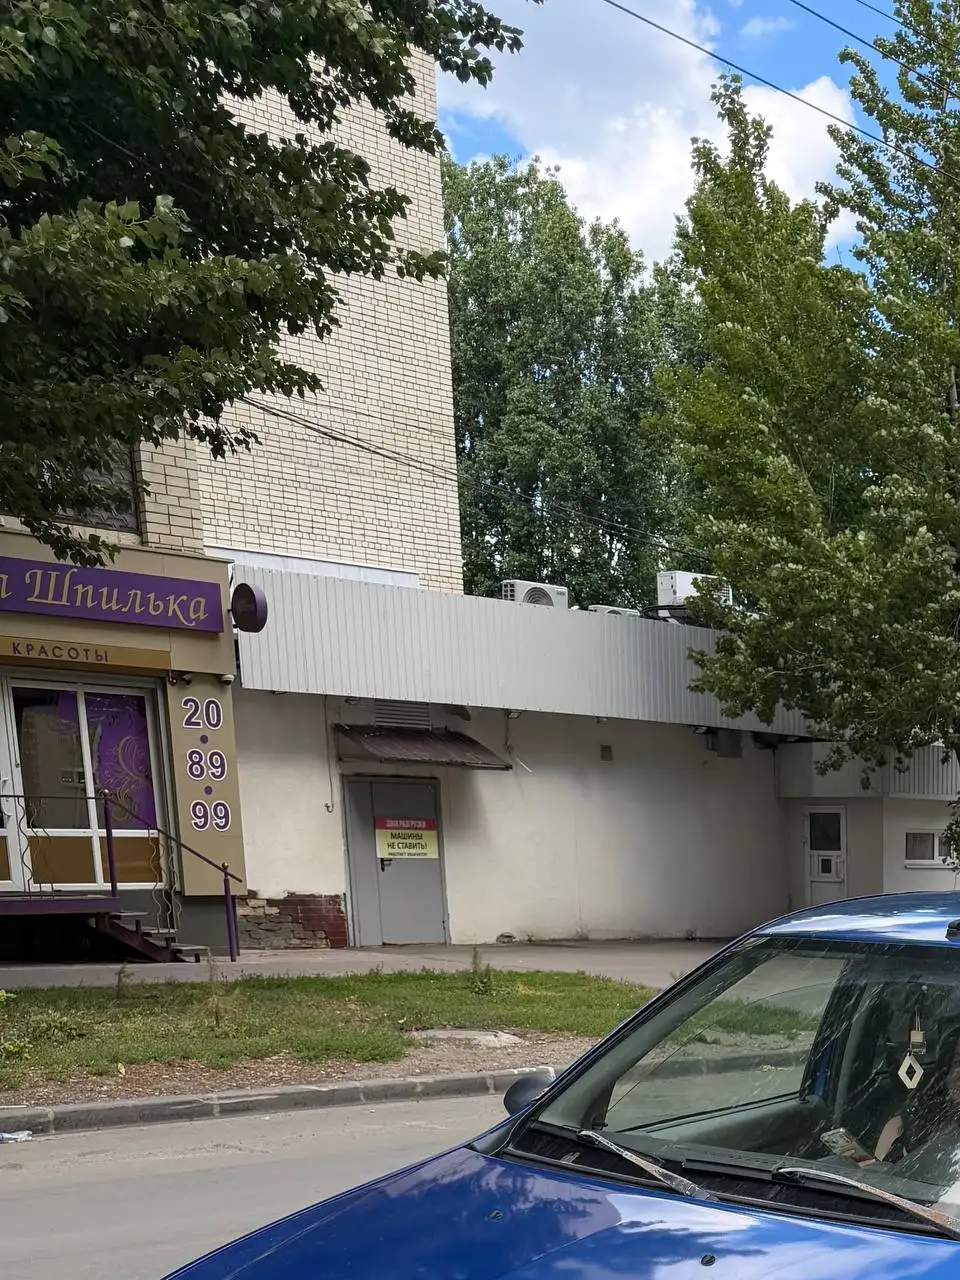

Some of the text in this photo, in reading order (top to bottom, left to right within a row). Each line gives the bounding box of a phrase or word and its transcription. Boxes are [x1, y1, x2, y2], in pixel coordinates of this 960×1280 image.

[25, 568, 208, 626] Шпилька
[12, 641, 108, 662] КРАСОТЫ
[181, 696, 223, 729] 20
[186, 749, 227, 781] 89
[190, 800, 232, 831] 99
[387, 842, 428, 850] НЕ СТАВИТЬ!
[390, 832, 423, 840] МАШИНЫ
